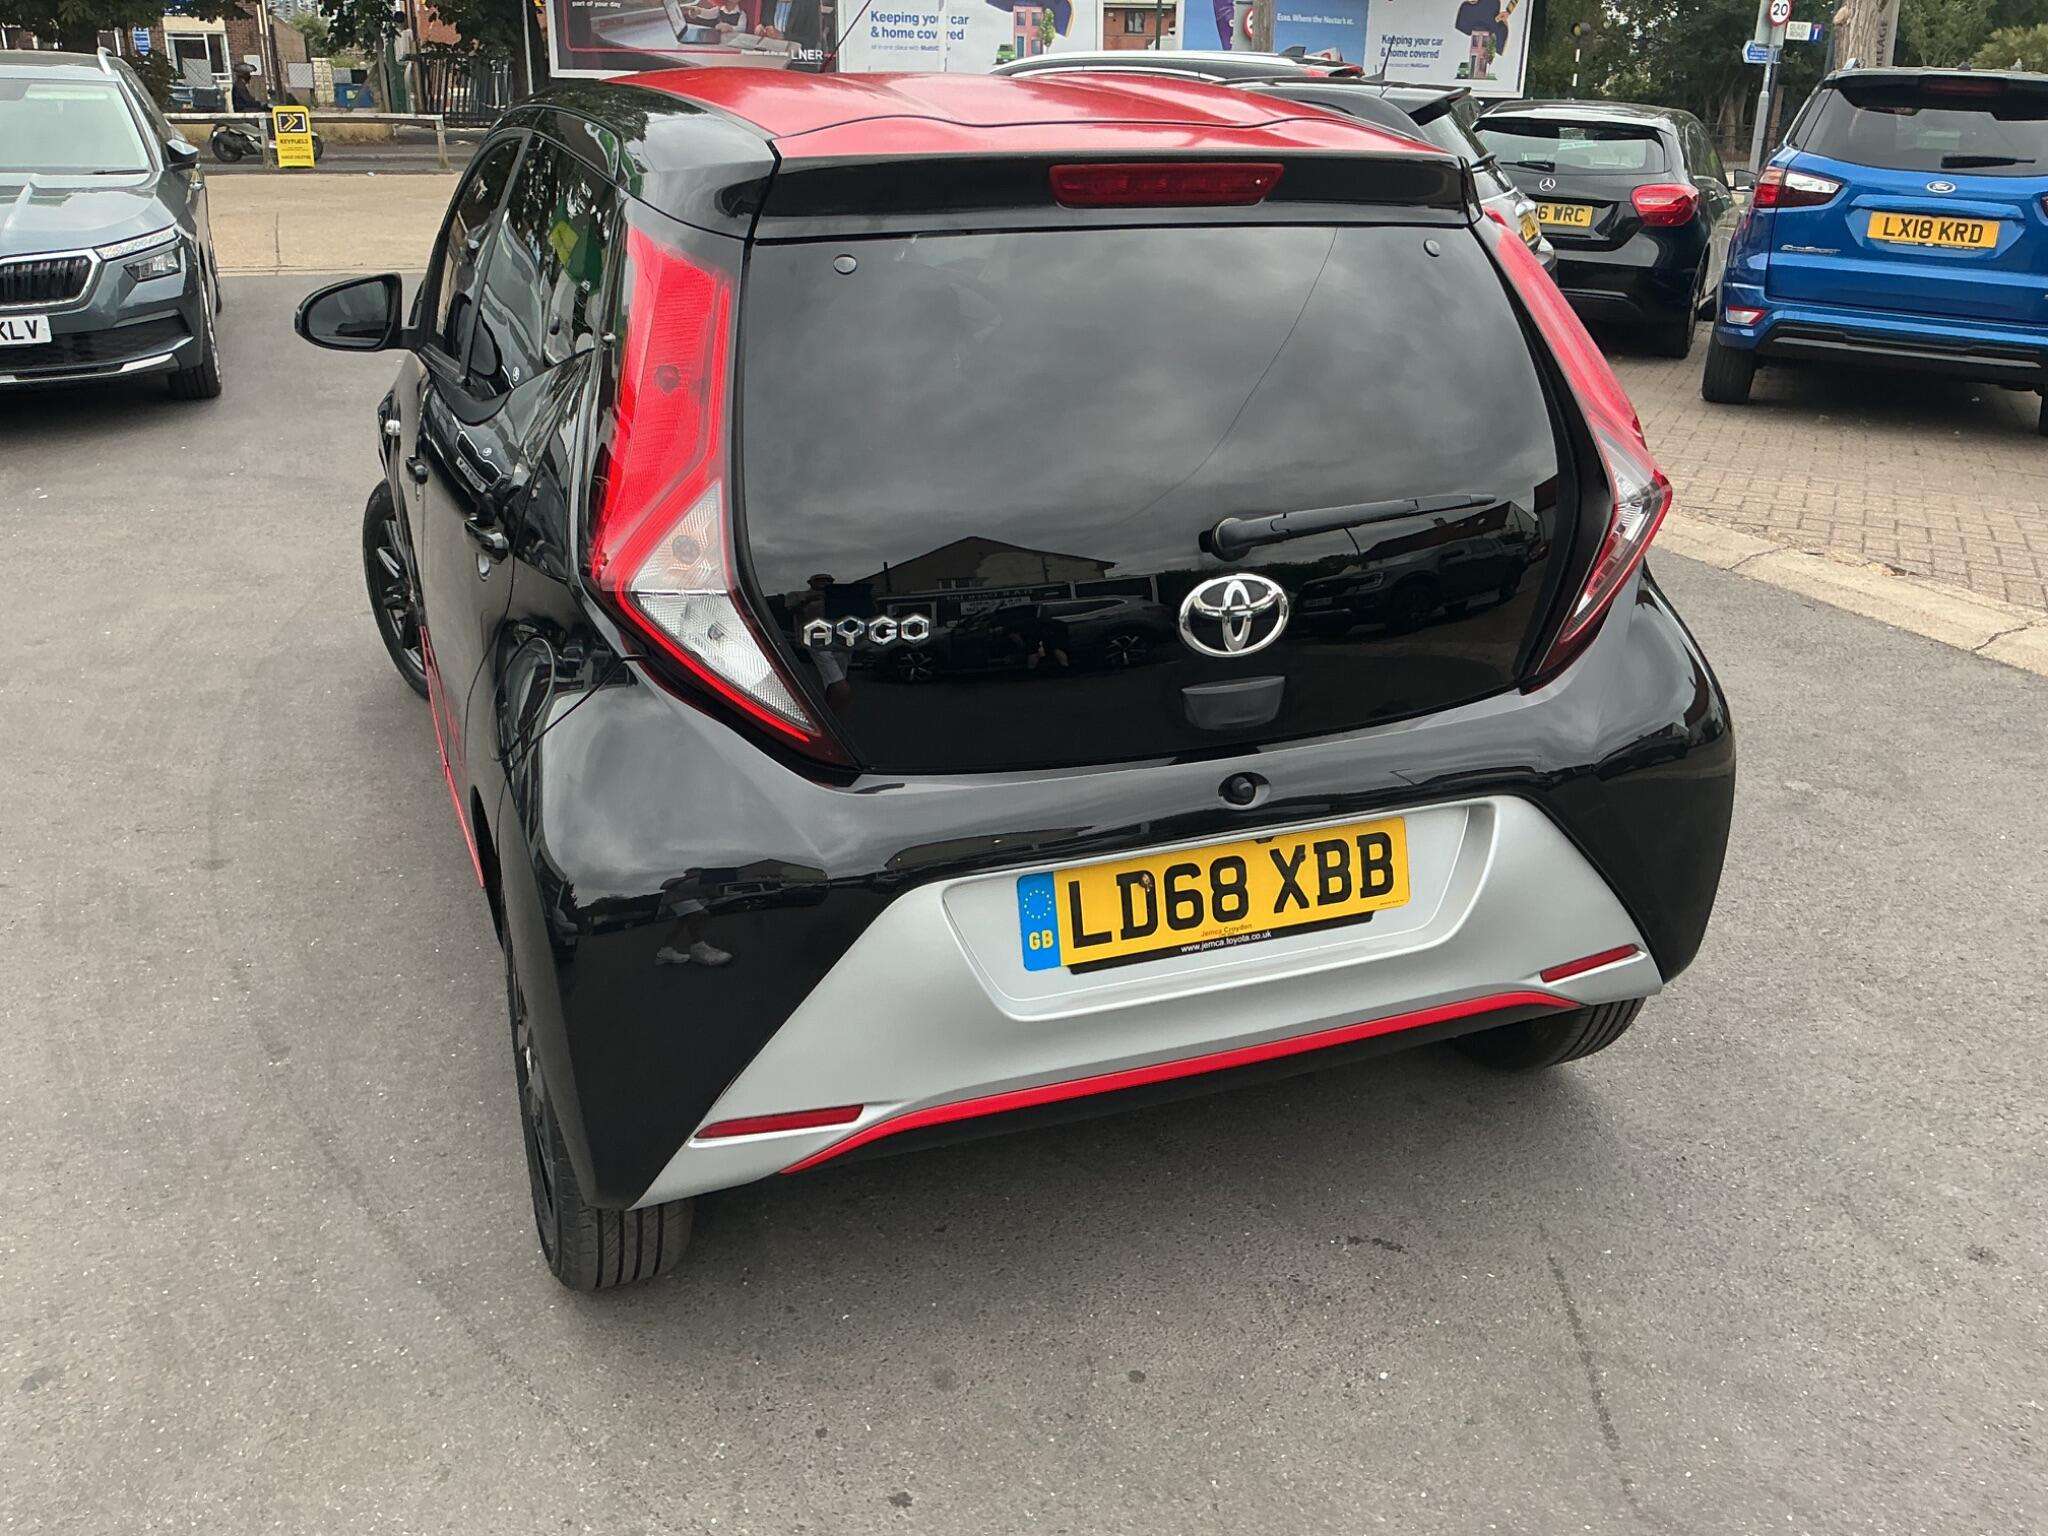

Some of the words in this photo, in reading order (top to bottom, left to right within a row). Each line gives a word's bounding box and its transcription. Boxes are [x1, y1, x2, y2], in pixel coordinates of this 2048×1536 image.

[1773, 3, 1788, 16] 20
[871, 11, 919, 26] Keeping
[922, 15, 948, 26] yo
[951, 16, 969, 25] car
[871, 26, 879, 38] &
[882, 27, 914, 39] home
[917, 29, 965, 40] covred
[1382, 35, 1412, 47] Keeping
[1414, 38, 1430, 47] your
[1431, 38, 1443, 46] car
[791, 48, 823, 61] LNER
[1410, 50, 1440, 58] covered
[1553, 205, 1585, 222] WRC
[1883, 216, 1933, 239] LX18
[1938, 221, 1984, 244] KRD
[802, 613, 931, 647] AYGO
[1068, 854, 1248, 949] LD68
[1269, 831, 1395, 913] XBB
[1028, 929, 1054, 951] GB
